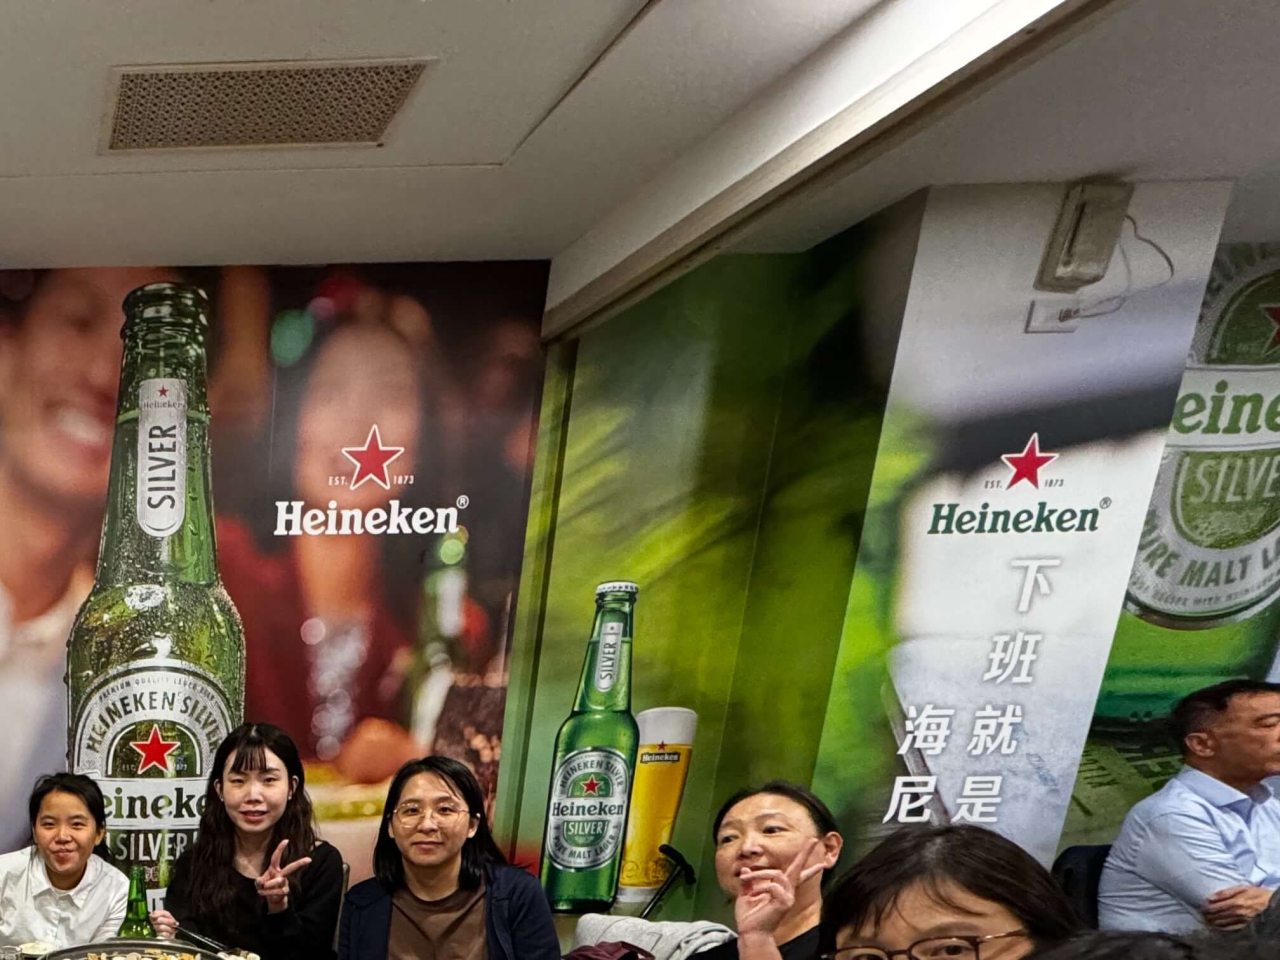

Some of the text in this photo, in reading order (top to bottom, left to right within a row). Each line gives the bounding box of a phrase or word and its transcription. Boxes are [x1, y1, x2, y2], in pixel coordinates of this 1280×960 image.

[147, 425, 177, 509] SILVER
[328, 475, 414, 485] EST. 1873
[1190, 455, 1280, 503] SILVE
[984, 479, 1064, 489] EST. 1873
[273, 500, 459, 535] Heineken
[927, 501, 1100, 534] Heineken
[1179, 555, 1252, 587] MALT
[600, 642, 617, 680] SILVER
[86, 691, 176, 754] HEINEKEN
[642, 753, 678, 763] Heineken
[560, 760, 603, 788] HEINEKEN
[552, 802, 624, 817] Heineken
[567, 821, 603, 835] SILVER
[115, 832, 188, 861] SILVER
[568, 850, 591, 859] MALT
